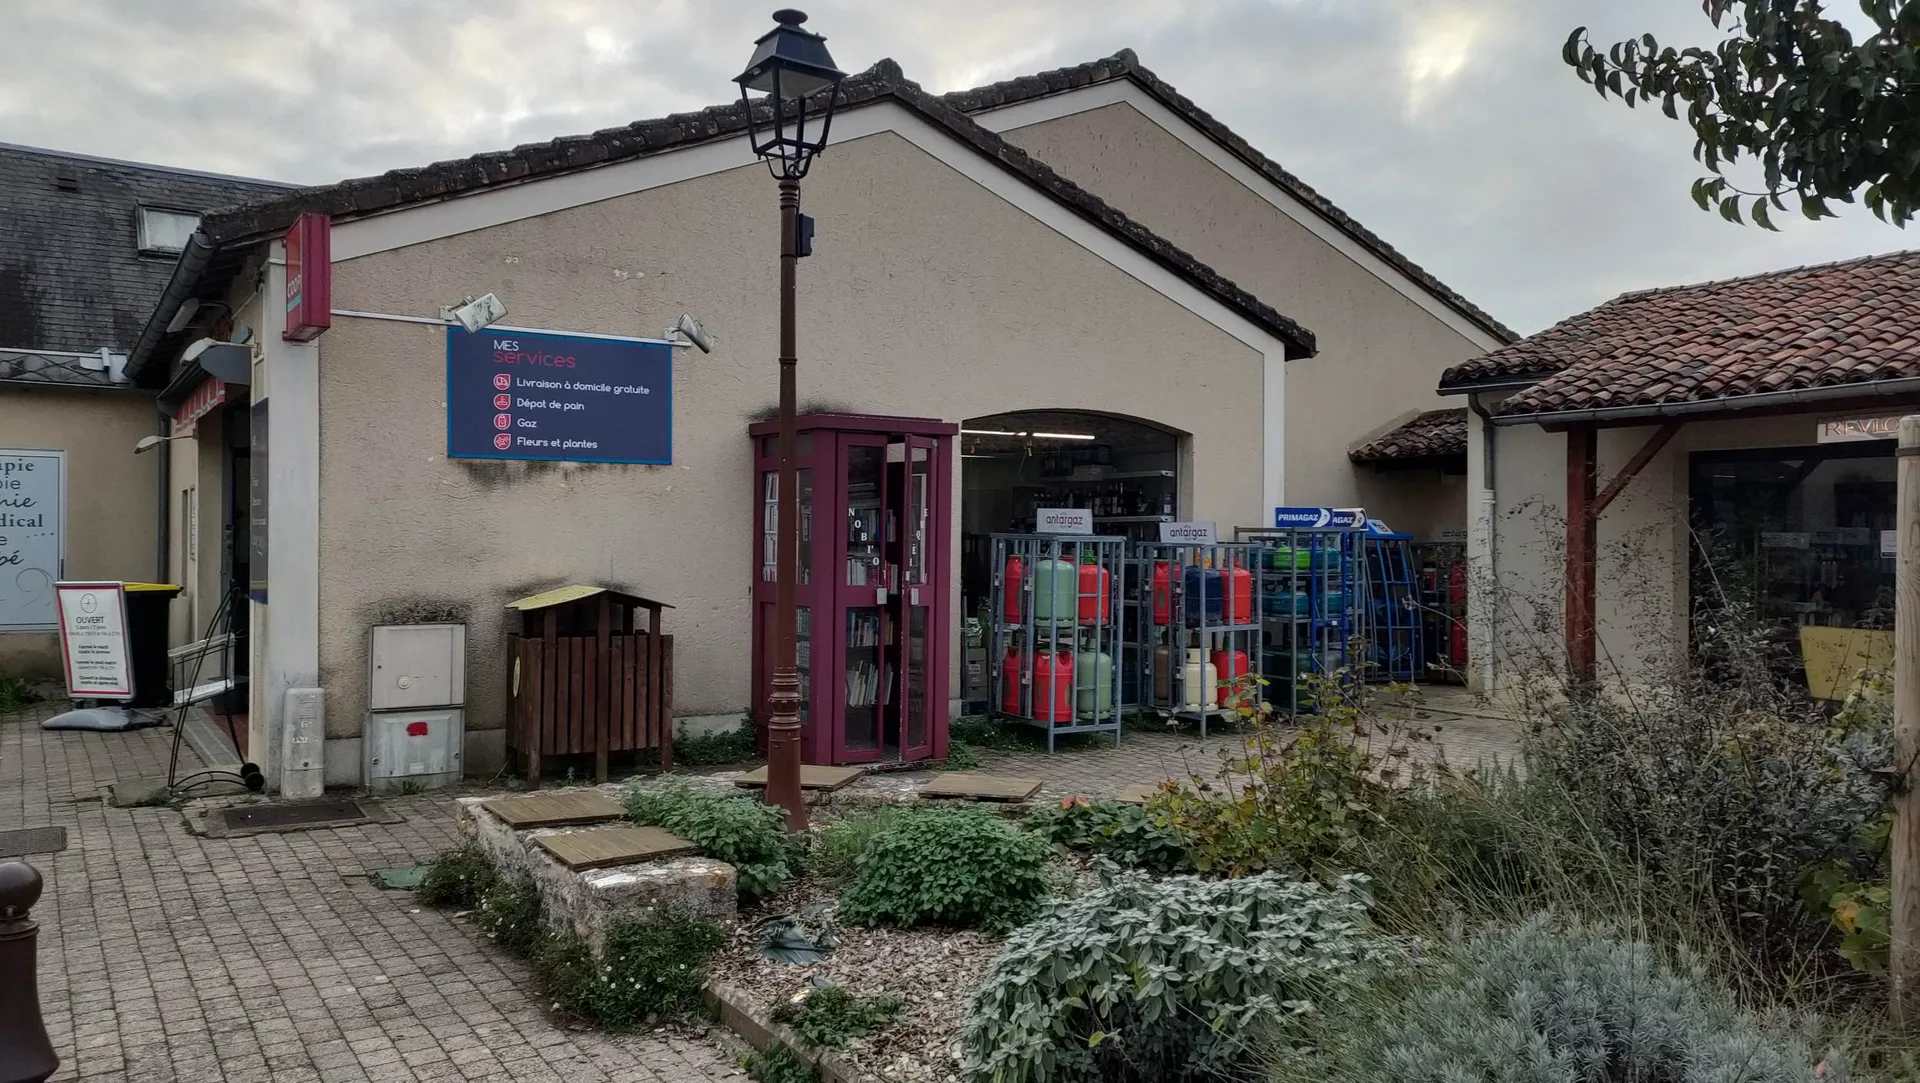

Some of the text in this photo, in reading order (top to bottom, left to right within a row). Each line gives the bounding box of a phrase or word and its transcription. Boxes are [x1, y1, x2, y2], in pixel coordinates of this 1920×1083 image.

[493, 340, 519, 351] MES
[494, 351, 575, 367] services
[517, 378, 650, 395] Livraison à domicile gratuite
[549, 400, 561, 409] de
[564, 401, 585, 411] pain
[517, 419, 537, 428] Gaz
[1825, 417, 1900, 437] REVLO
[517, 437, 598, 449] Fleurs et plantes
[0, 458, 35, 475] pie
[1045, 514, 1083, 528] antargaz
[1278, 514, 1319, 522] PRIMAGAZ
[1332, 516, 1354, 524] AGAZ
[1169, 526, 1207, 541] antargaz
